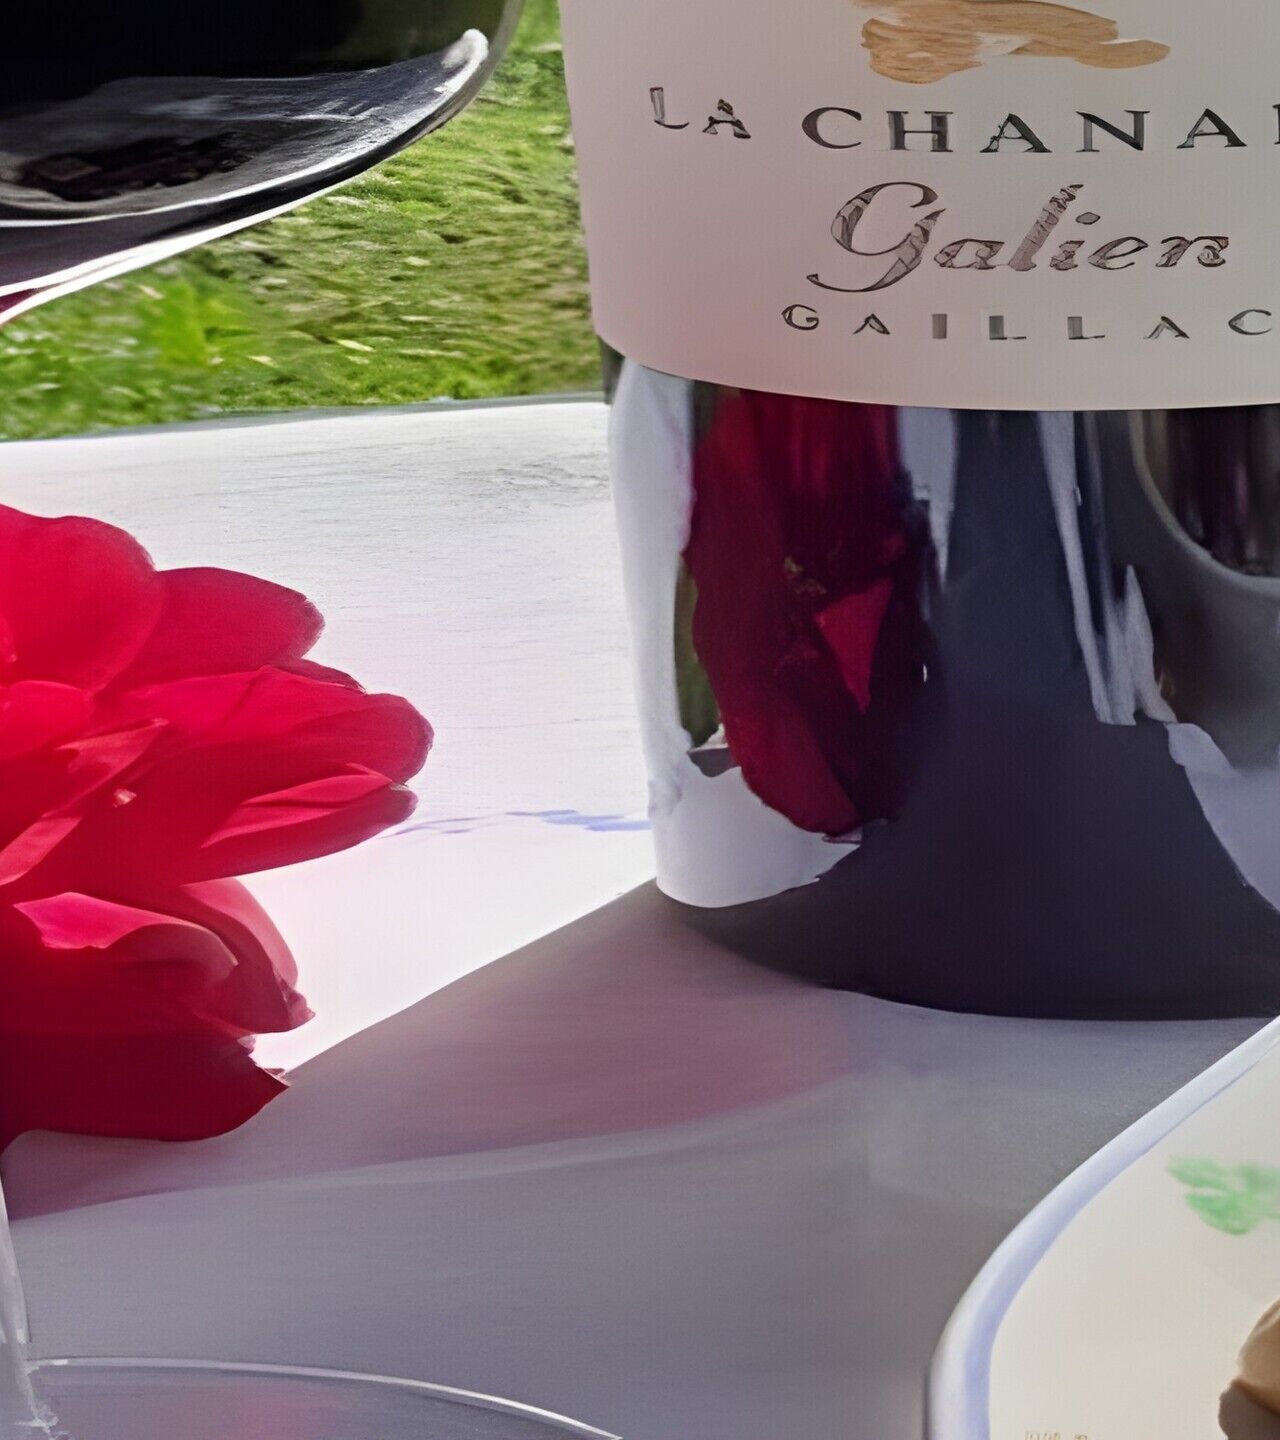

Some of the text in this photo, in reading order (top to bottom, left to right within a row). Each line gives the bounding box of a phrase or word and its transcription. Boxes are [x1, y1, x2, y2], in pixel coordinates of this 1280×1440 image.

[649, 86, 751, 140] LA
[805, 180, 1231, 294] Galien
[781, 303, 1274, 342] GAILLAC
